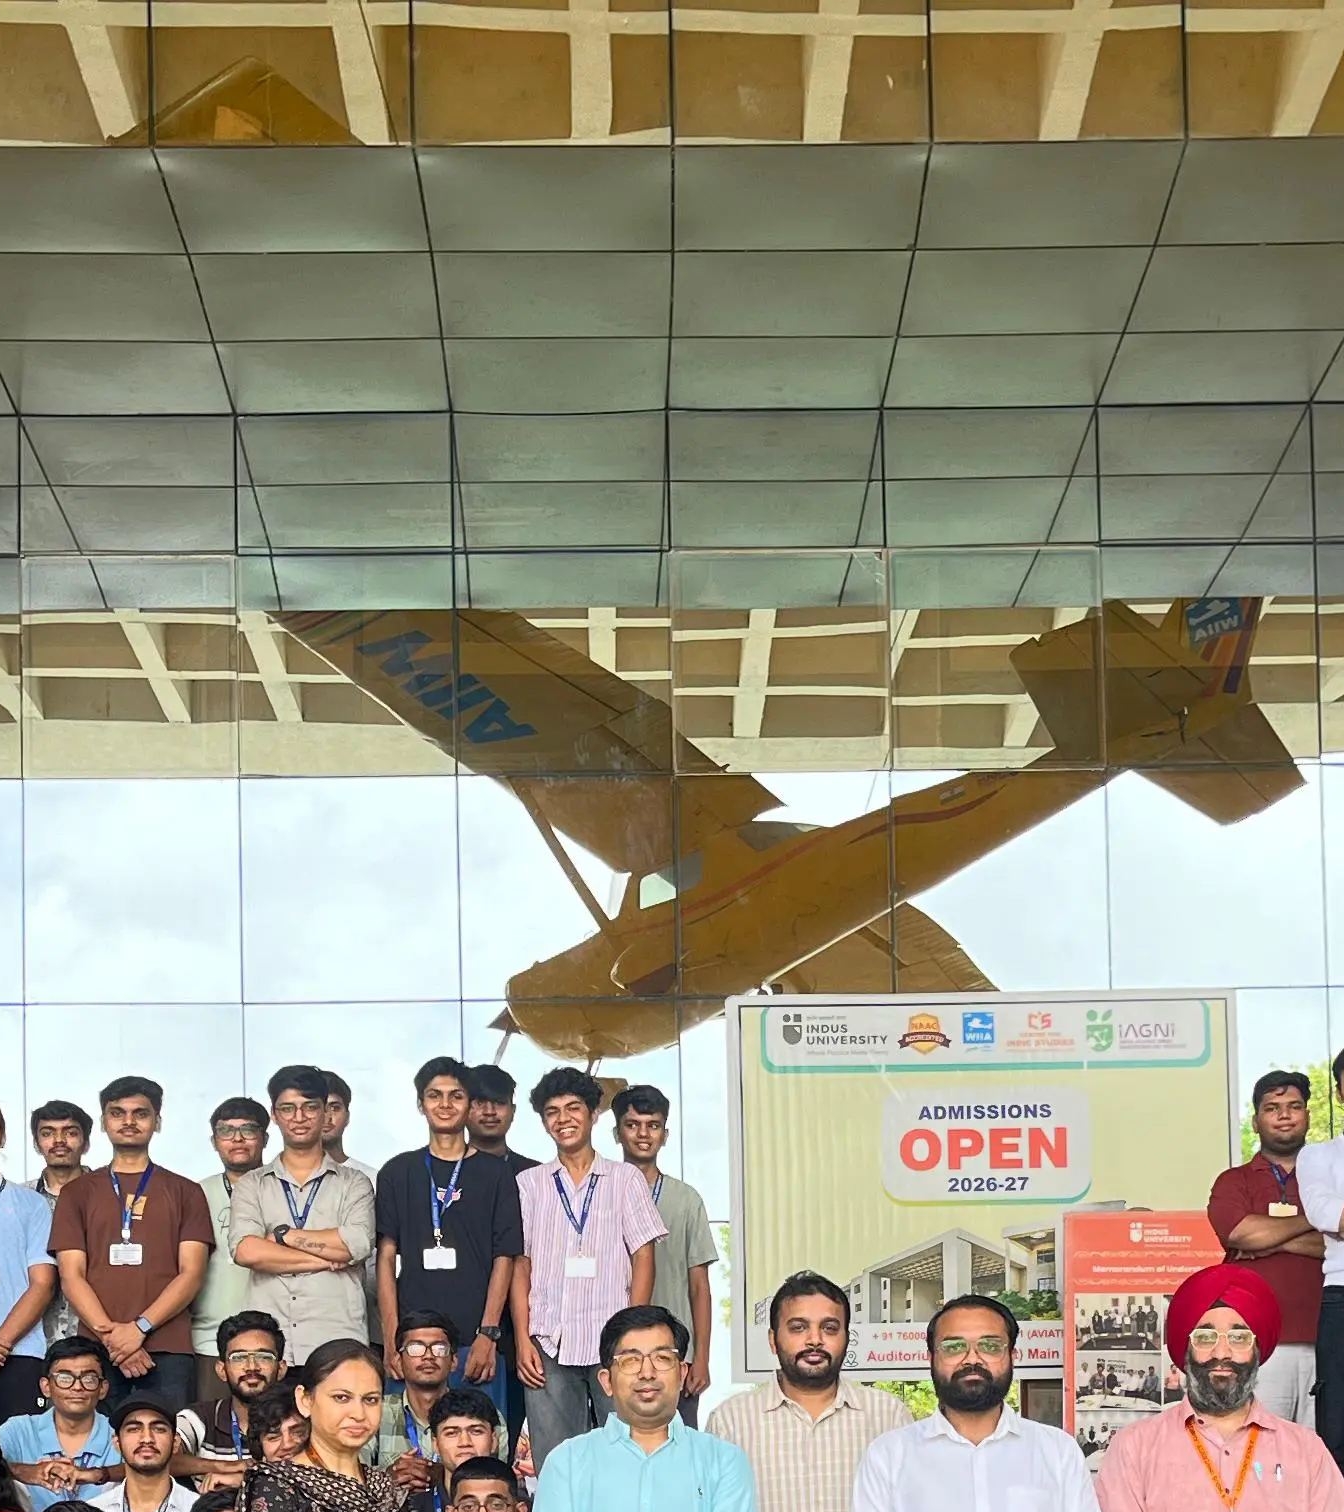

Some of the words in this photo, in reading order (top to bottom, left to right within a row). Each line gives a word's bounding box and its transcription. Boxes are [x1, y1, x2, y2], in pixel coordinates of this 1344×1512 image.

[806, 1024, 848, 1034] INDUS
[911, 1022, 938, 1031] NAAC
[806, 1035, 888, 1046] UNIVERSITY
[918, 1104, 1052, 1120] ADMISSIONS
[900, 1127, 1068, 1171] OPEN
[948, 1176, 1029, 1192] 2026-27
[1092, 1265, 1155, 1273] Memorandum
[1156, 1265, 1166, 1273] of
[882, 1331, 894, 1341] 91
[867, 1350, 931, 1362] Auditoriu
[1028, 1348, 1059, 1359] Main
